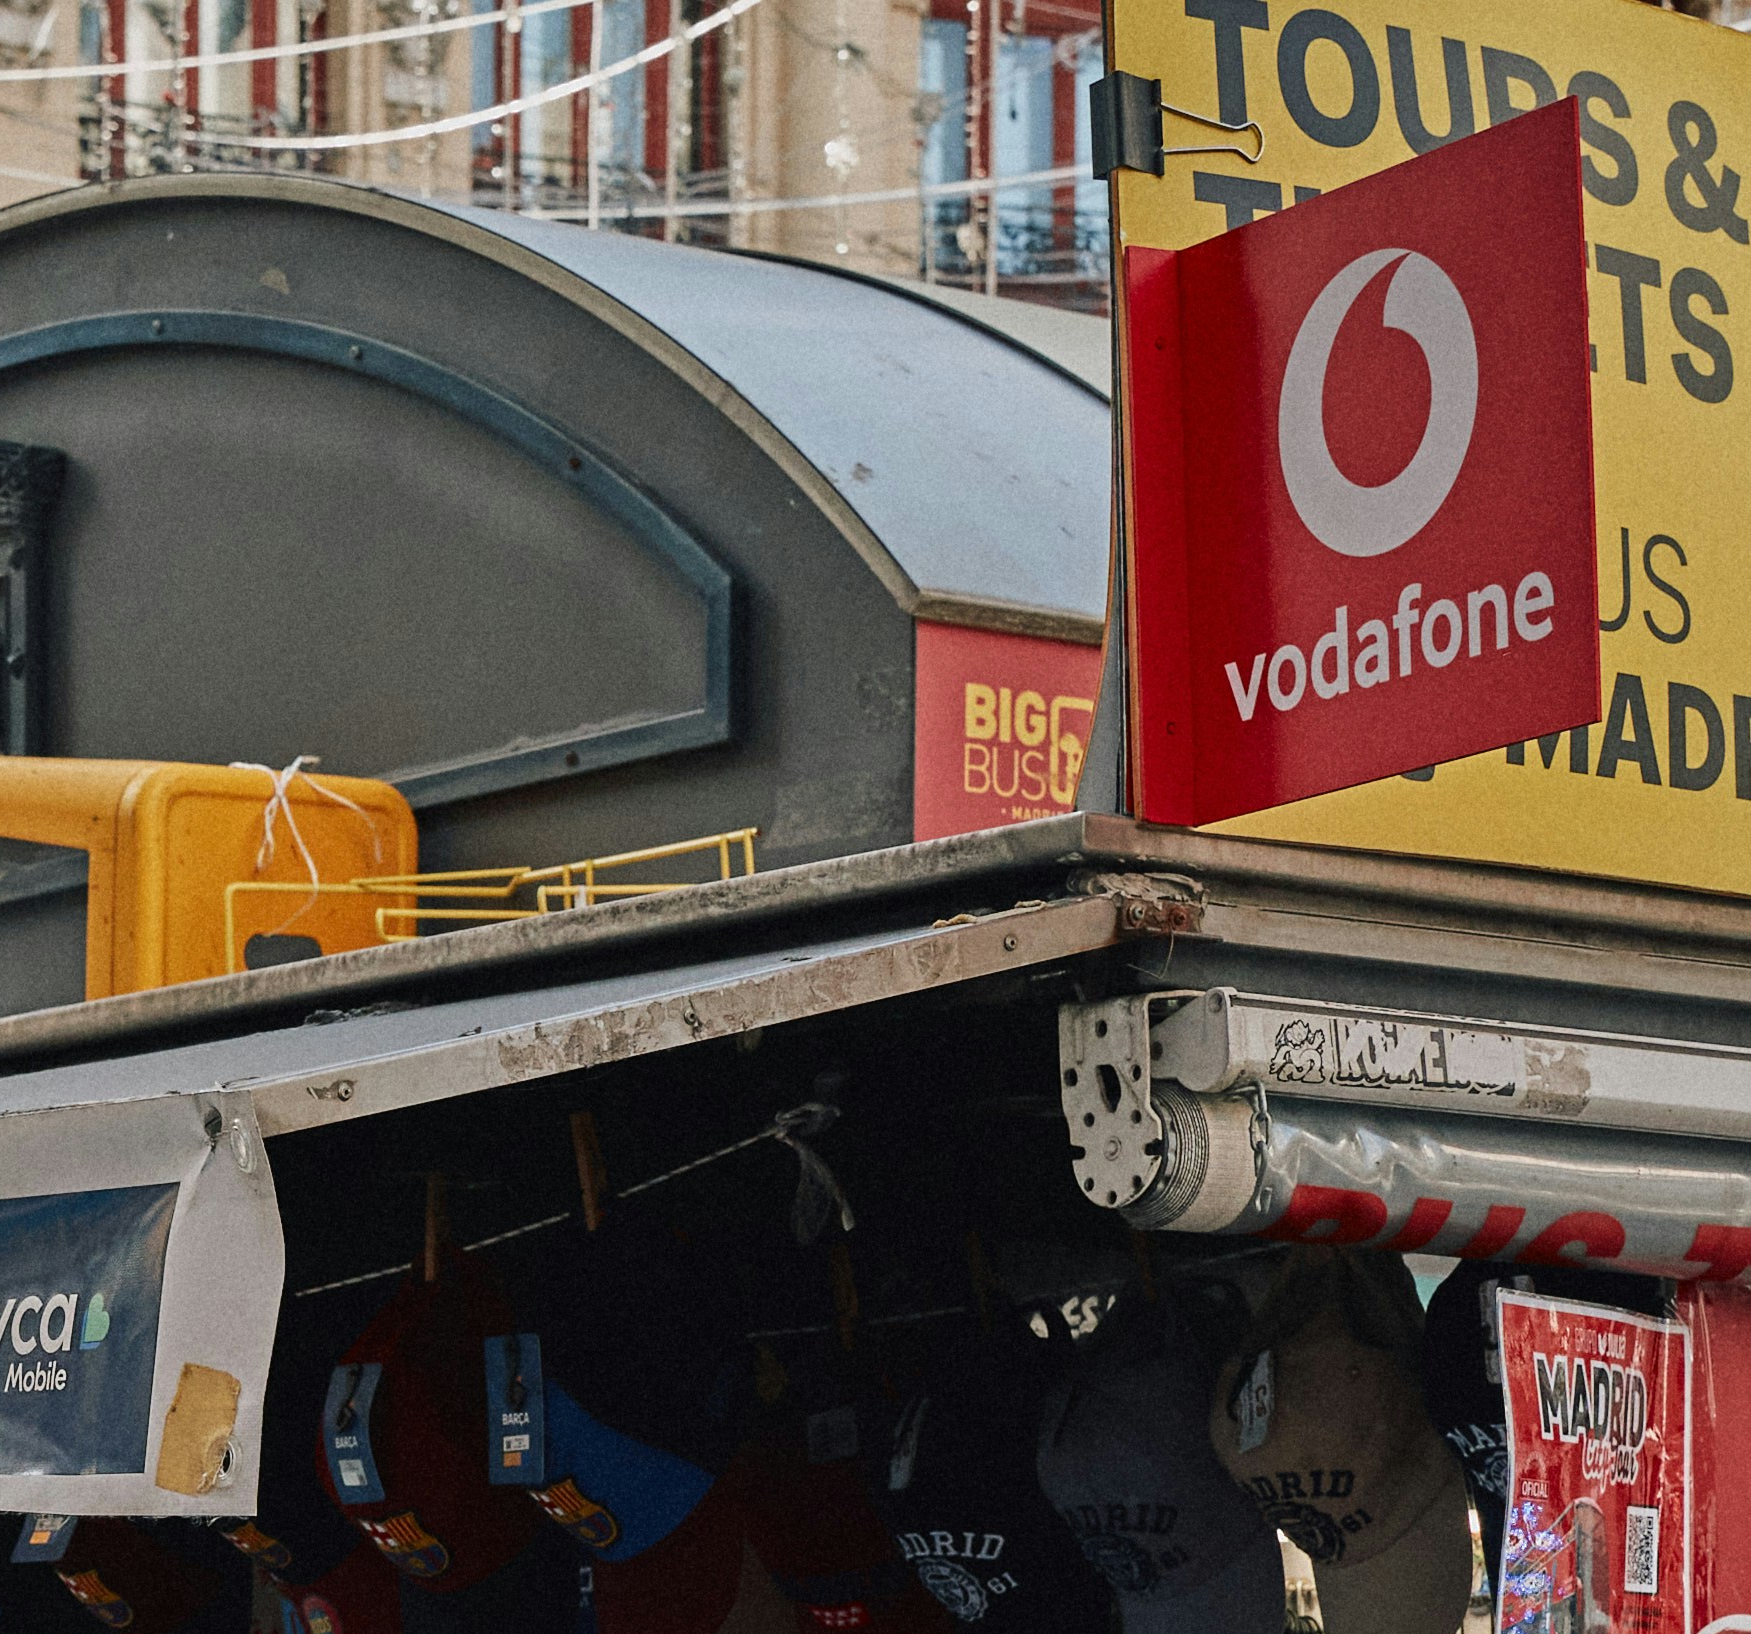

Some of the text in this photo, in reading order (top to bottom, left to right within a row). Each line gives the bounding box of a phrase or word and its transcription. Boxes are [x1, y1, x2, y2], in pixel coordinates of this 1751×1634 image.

[1664, 101, 1750, 245] &
[1224, 570, 1554, 722] vodafone
[965, 682, 1047, 747] BIG
[964, 742, 1047, 801] BUS
[4, 1362, 68, 1395] Mobile
[1533, 1352, 1647, 1452] MADRID
